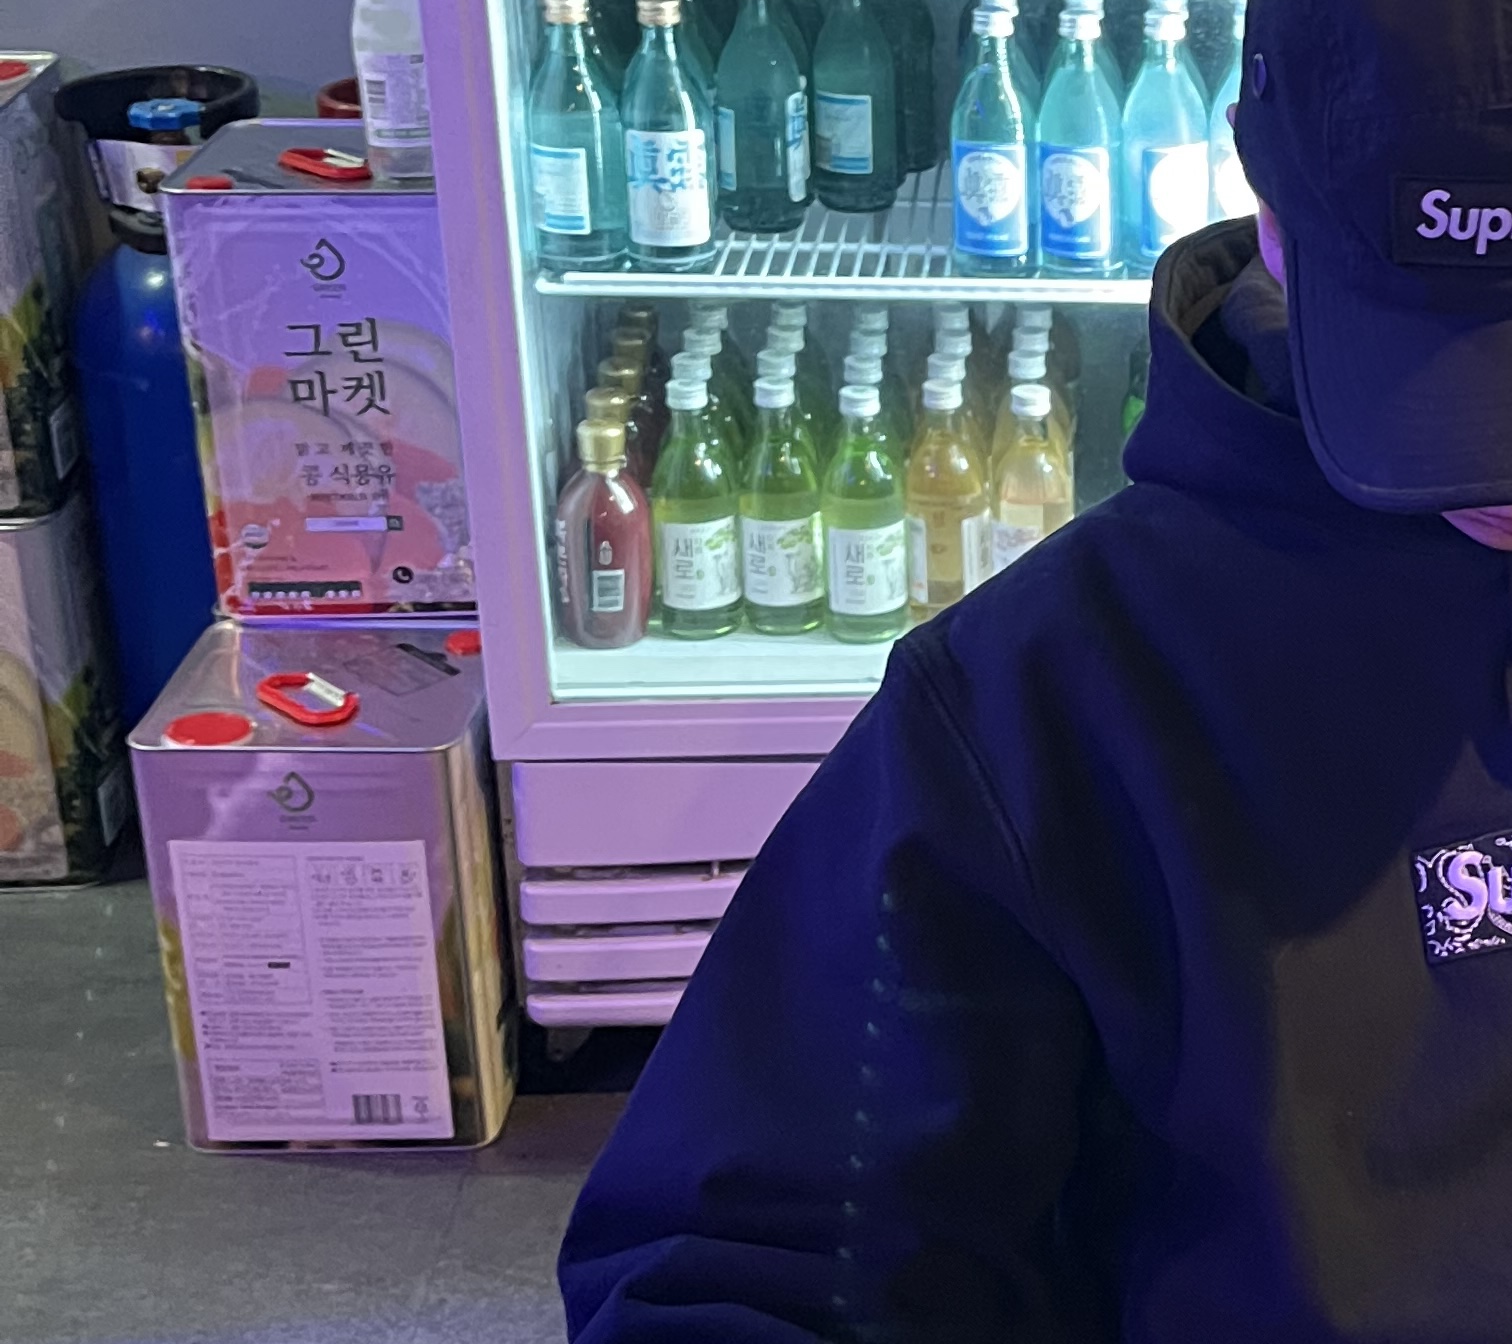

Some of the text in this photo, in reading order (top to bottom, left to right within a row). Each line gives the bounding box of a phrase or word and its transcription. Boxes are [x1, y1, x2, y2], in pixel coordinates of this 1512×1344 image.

[283, 317, 384, 364] 그린
[289, 368, 393, 420] 마켓
[673, 536, 696, 580] 새로
[748, 532, 771, 577] 새로
[844, 542, 866, 586] 새로
